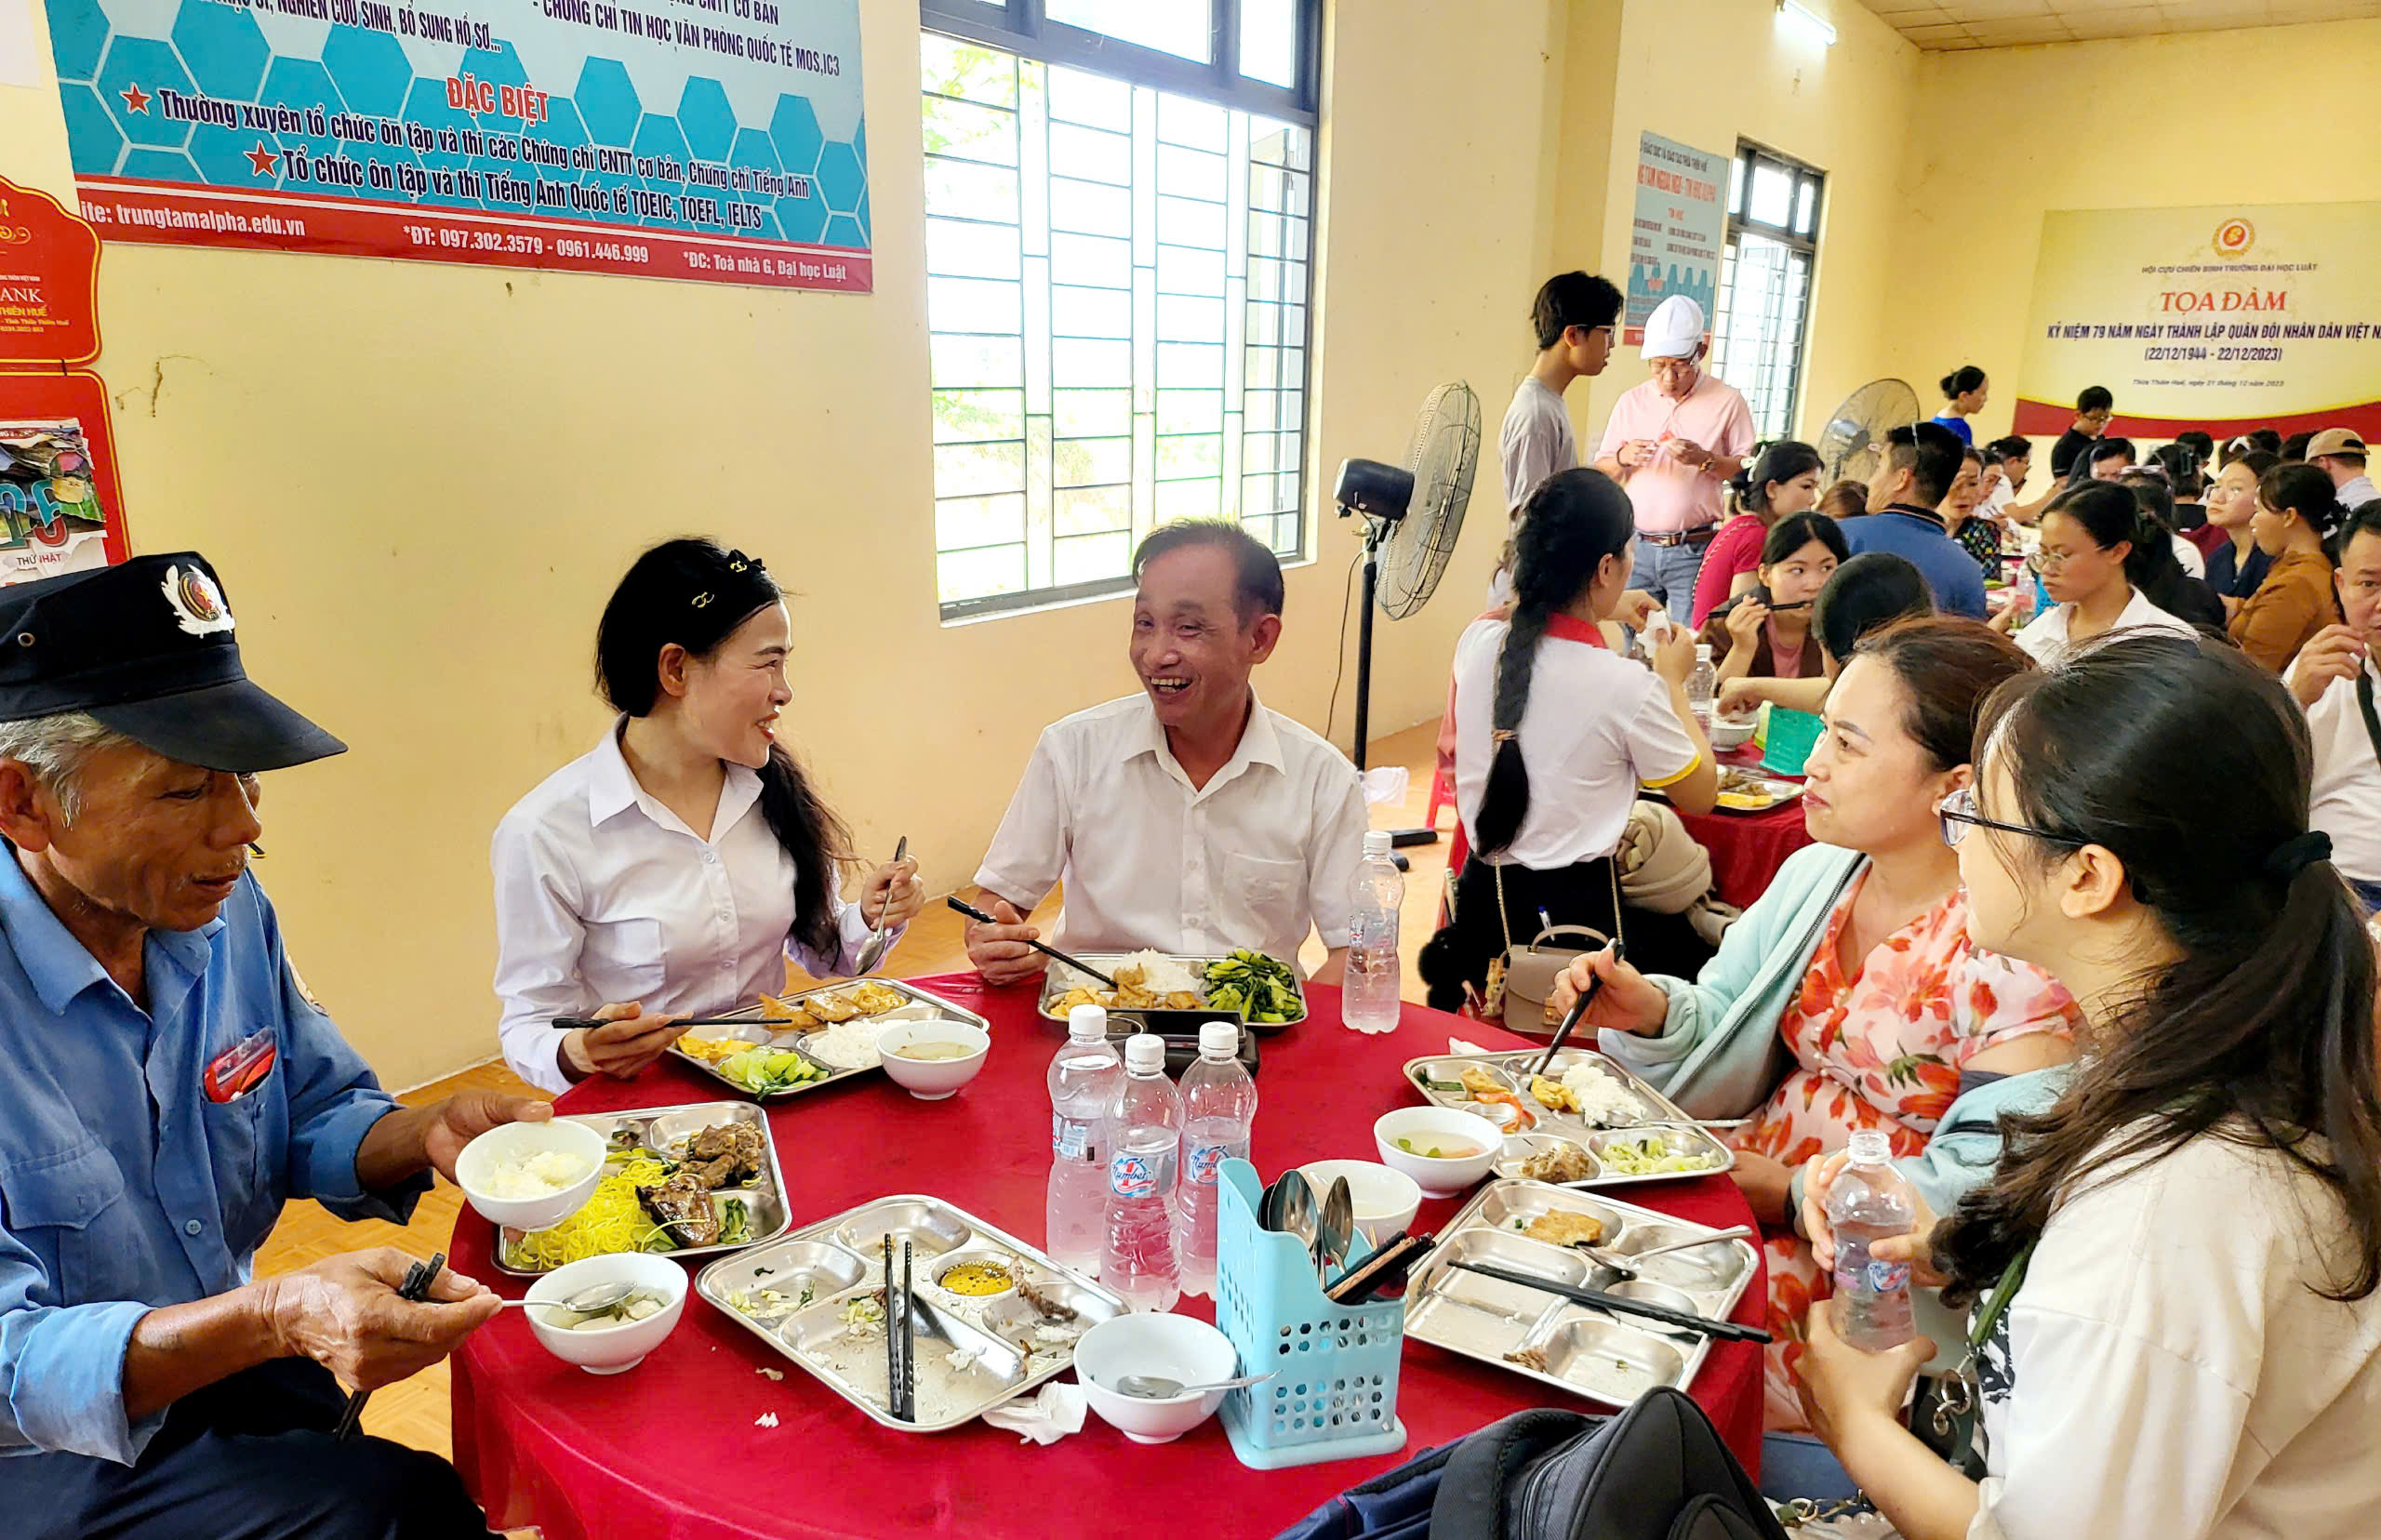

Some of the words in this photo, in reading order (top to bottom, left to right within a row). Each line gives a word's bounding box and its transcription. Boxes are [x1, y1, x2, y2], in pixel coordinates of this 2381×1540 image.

[360, 1, 396, 36] SINH,
[419, 12, 452, 43] SUNG
[620, 9, 643, 35] TIN
[645, 15, 672, 46] HỌC
[674, 18, 699, 47] VĂN
[703, 26, 744, 57] PHÒNG
[747, 33, 777, 64] QUỐC
[779, 39, 792, 67] TẾ
[446, 73, 494, 117] ĐẶC
[500, 84, 548, 126] BIỆT
[159, 90, 237, 128] Thường
[243, 104, 301, 133] xuyên
[307, 104, 325, 136] tổ
[331, 113, 375, 141] chức
[380, 119, 402, 145] ôn
[406, 123, 433, 153] tập
[438, 126, 458, 153] và
[462, 130, 483, 155] thi
[488, 134, 516, 160] các
[522, 138, 567, 169] Chứng
[572, 143, 594, 169] chỉ
[599, 149, 632, 174] CNTT
[638, 158, 653, 177] cơ
[658, 156, 685, 183] bản,
[689, 162, 727, 189] Chứng
[731, 166, 750, 191] chỉ
[752, 168, 784, 197] Tiếng
[788, 176, 809, 198] Anh
[283, 145, 308, 179] Tổ
[314, 154, 363, 186] chức
[369, 160, 392, 190] ôn
[398, 163, 426, 196] tập
[432, 167, 452, 195] và
[458, 170, 481, 198] thi
[485, 170, 530, 206] Tiếng
[536, 179, 565, 207] Anh
[570, 182, 608, 212] Quốc
[614, 183, 627, 213] tế
[632, 191, 677, 221] TOEIC,
[680, 197, 724, 227] TOEFL,
[727, 203, 761, 228] IELTS
[117, 204, 305, 235] trungtamalpha.edu.vn
[440, 229, 542, 254] 097.302.3579
[557, 239, 648, 262] 0961.446.999
[713, 254, 735, 271] Toà
[738, 257, 760, 272] nhà
[778, 259, 796, 278] Đại
[800, 262, 819, 280] học
[823, 264, 846, 282] Luật
[2161, 291, 2215, 315] TỌA
[2221, 286, 2287, 311] ĐÀM
[2093, 325, 2106, 339] 79
[2228, 322, 2258, 339] QUÂN
[2282, 322, 2315, 339] NHÂN
[2318, 322, 2342, 339] DÂN
[2346, 322, 2370, 342] VIỆT
